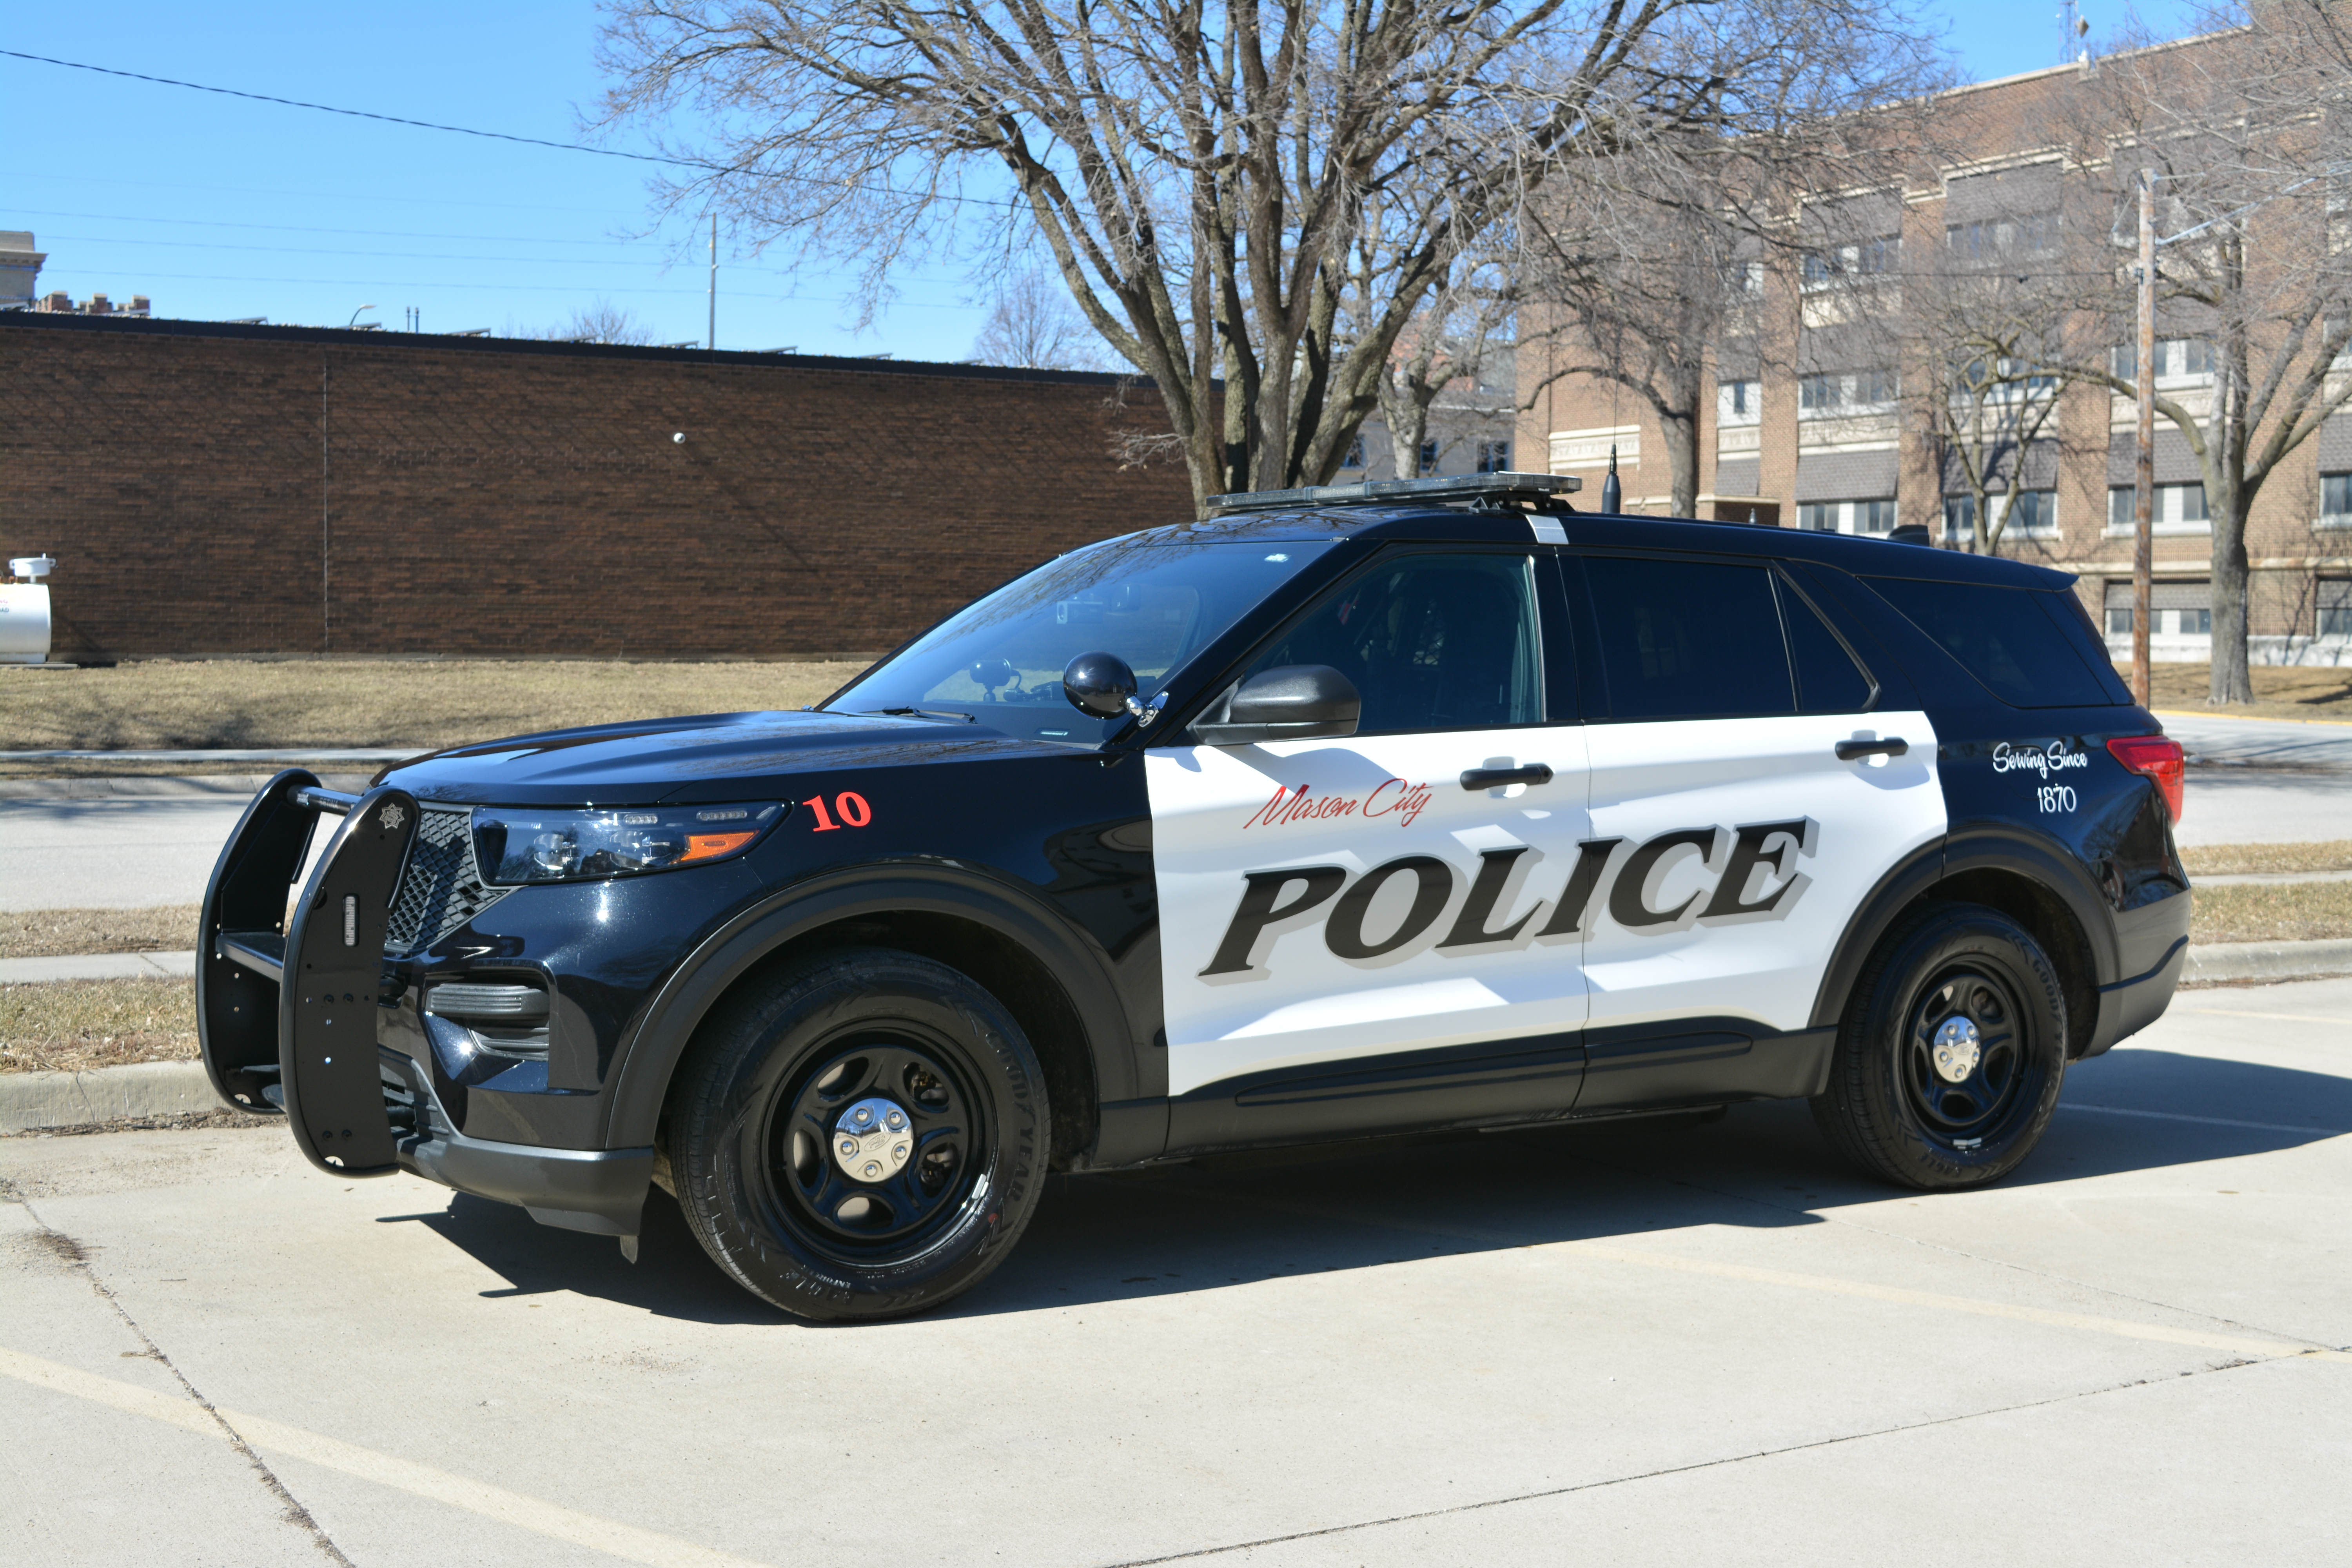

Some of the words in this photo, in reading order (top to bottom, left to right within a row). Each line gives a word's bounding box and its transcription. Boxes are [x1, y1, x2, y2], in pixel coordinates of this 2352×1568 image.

[1993, 742, 2048, 779] Serving
[2047, 740, 2088, 770] Since
[802, 791, 871, 831] 10
[1243, 784, 1360, 828] Mason
[1362, 778, 1434, 827] City
[2037, 786, 2076, 813] 1870
[1195, 815, 1819, 982] POLICE
